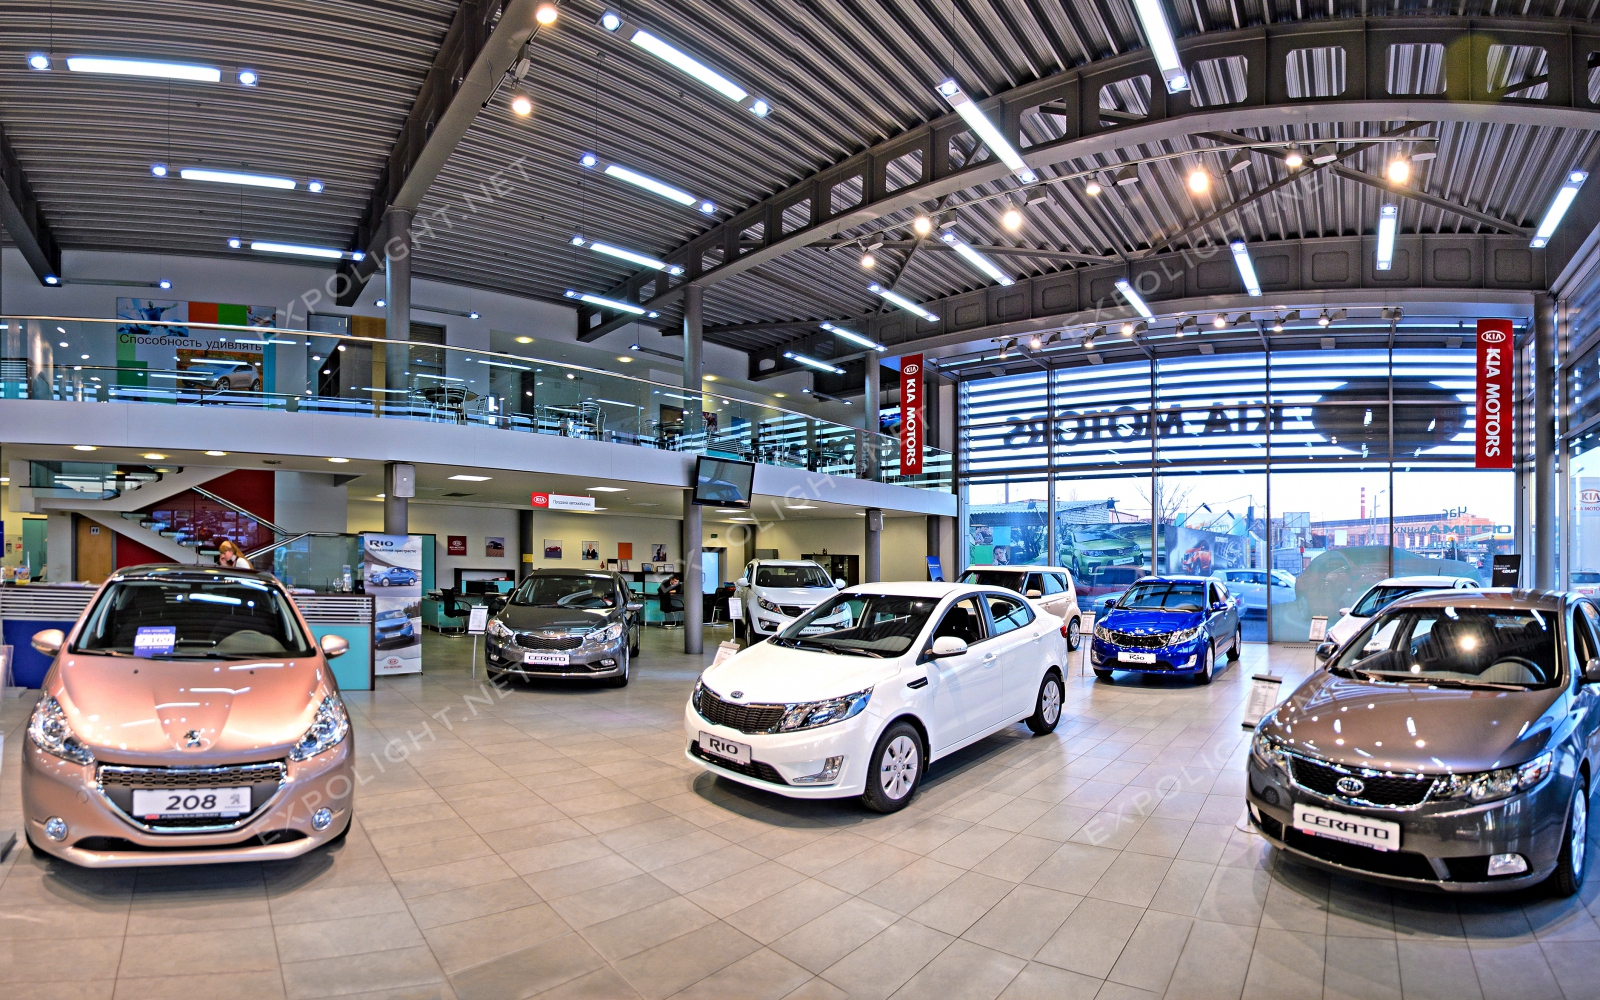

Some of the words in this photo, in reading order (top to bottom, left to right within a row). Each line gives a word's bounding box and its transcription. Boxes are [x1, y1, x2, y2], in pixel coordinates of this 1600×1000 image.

[119, 333, 203, 348] Способность
[205, 339, 262, 351] удивлять
[1485, 333, 1502, 341] KIA
[906, 365, 917, 373] KIA
[1486, 348, 1501, 378] KIA
[906, 378, 916, 403] KIA
[1485, 383, 1501, 458] MOTORS
[906, 407, 916, 466] MOTORS
[709, 737, 738, 755] RIO
[165, 794, 217, 811] 208
[1302, 812, 1389, 840] CERATO
